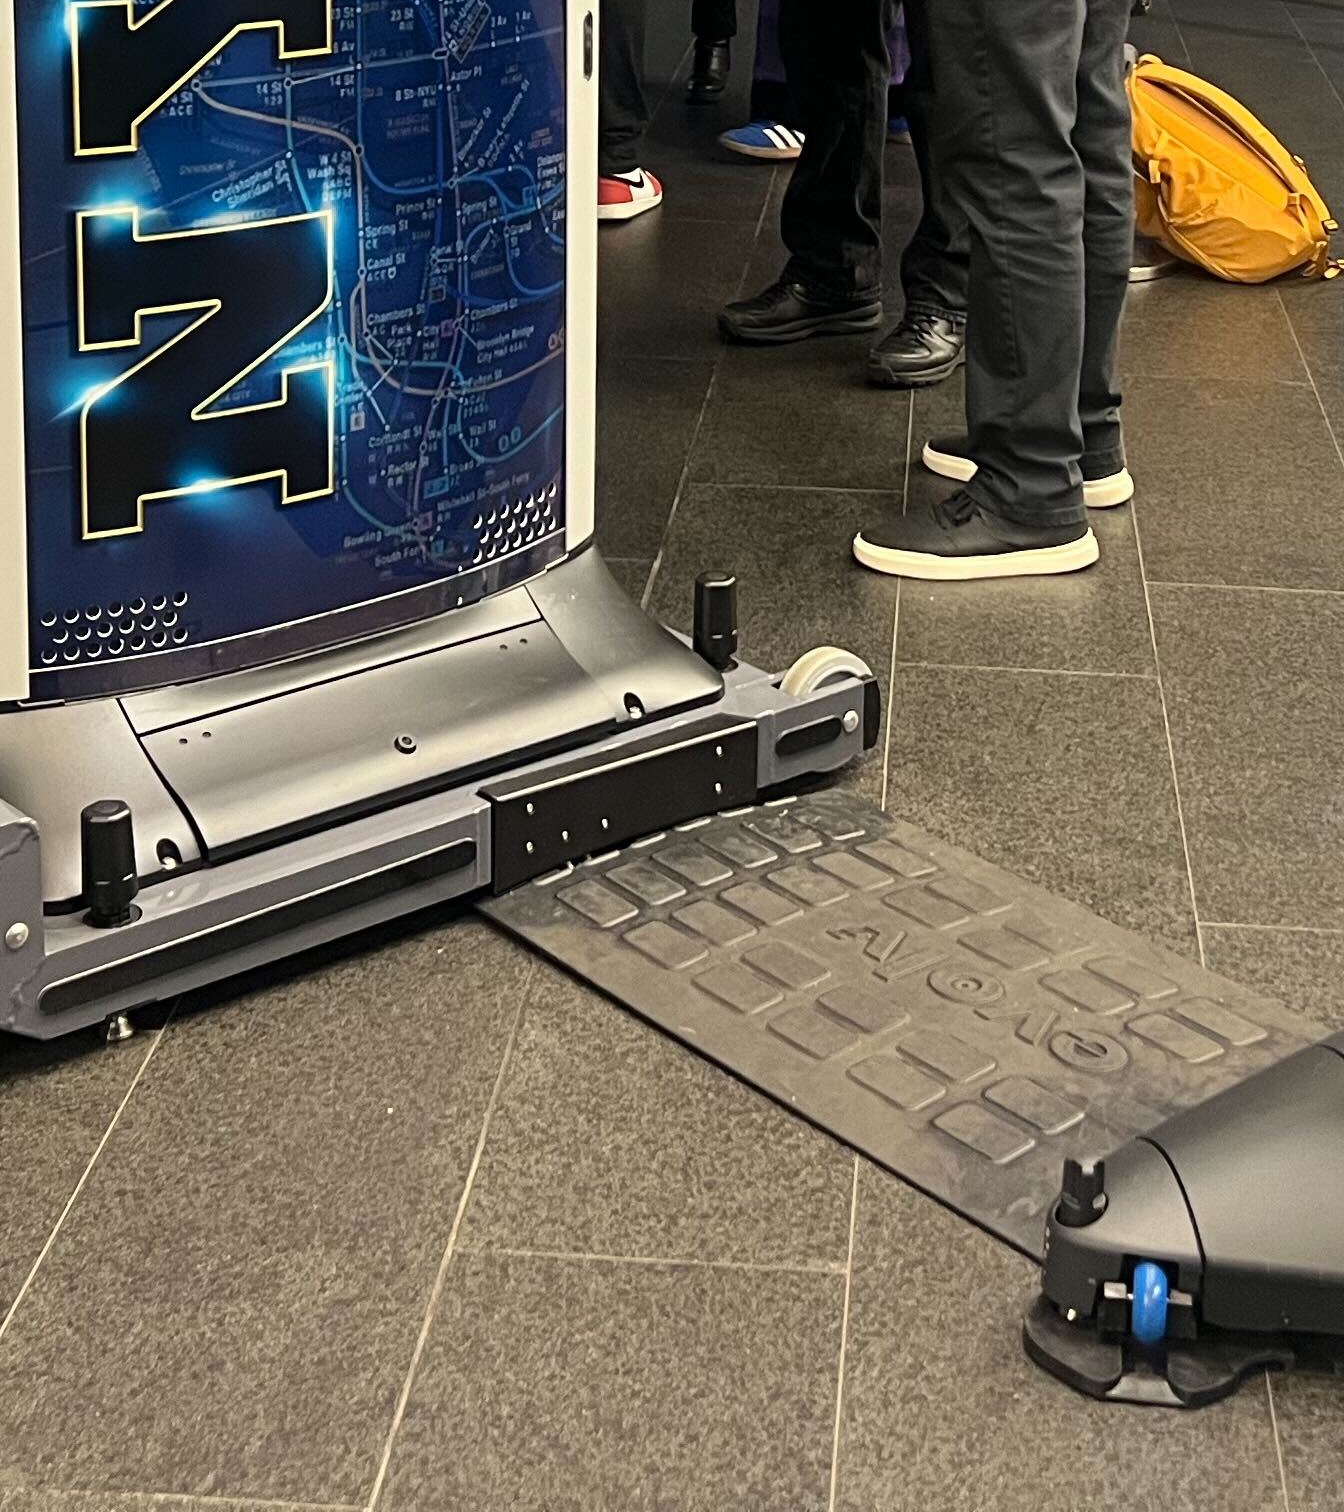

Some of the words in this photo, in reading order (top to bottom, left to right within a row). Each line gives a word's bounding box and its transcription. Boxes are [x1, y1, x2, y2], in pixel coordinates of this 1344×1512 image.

[212, 166, 273, 202] Christopher
[365, 224, 396, 238] Spring
[366, 257, 393, 270] Canal
[367, 308, 413, 325] Chambers
[826, 922, 1131, 1073] evolv
